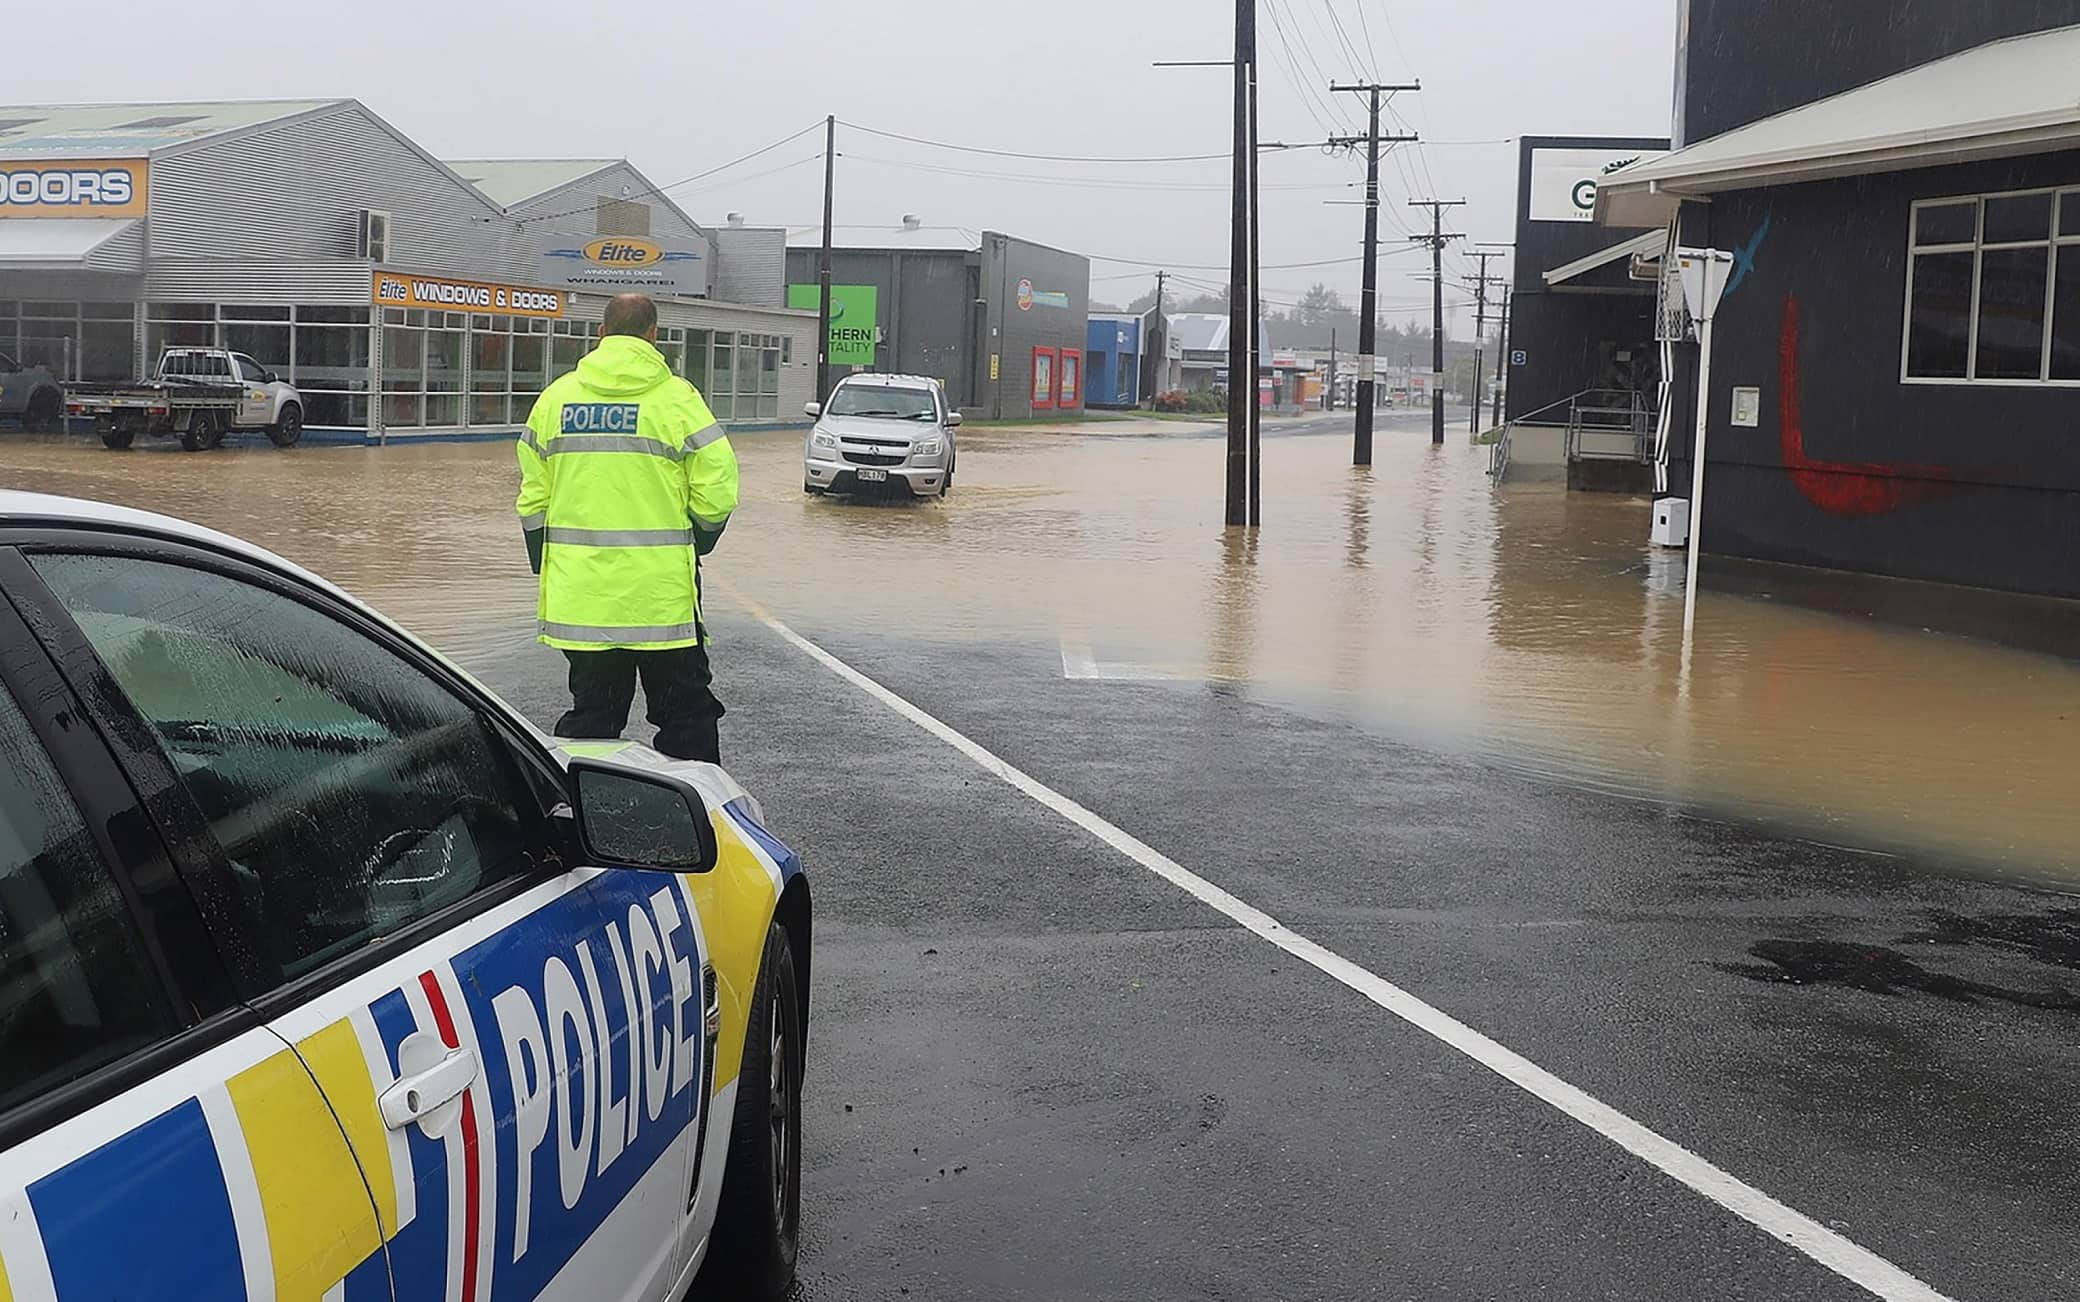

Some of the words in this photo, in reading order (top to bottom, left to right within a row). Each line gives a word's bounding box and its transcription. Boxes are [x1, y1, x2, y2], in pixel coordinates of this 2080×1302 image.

[0, 170, 132, 205] OORS
[598, 242, 646, 262] Élite
[567, 278, 675, 286] WHANGAREI
[412, 281, 490, 306] WINDOWS
[495, 288, 507, 307] &
[511, 290, 558, 312] DOORS
[831, 329, 871, 341] HERN
[830, 342, 870, 353] TALITY
[1513, 351, 1525, 364] 8
[562, 406, 638, 431] POLICE
[491, 885, 695, 1262] POLICE
